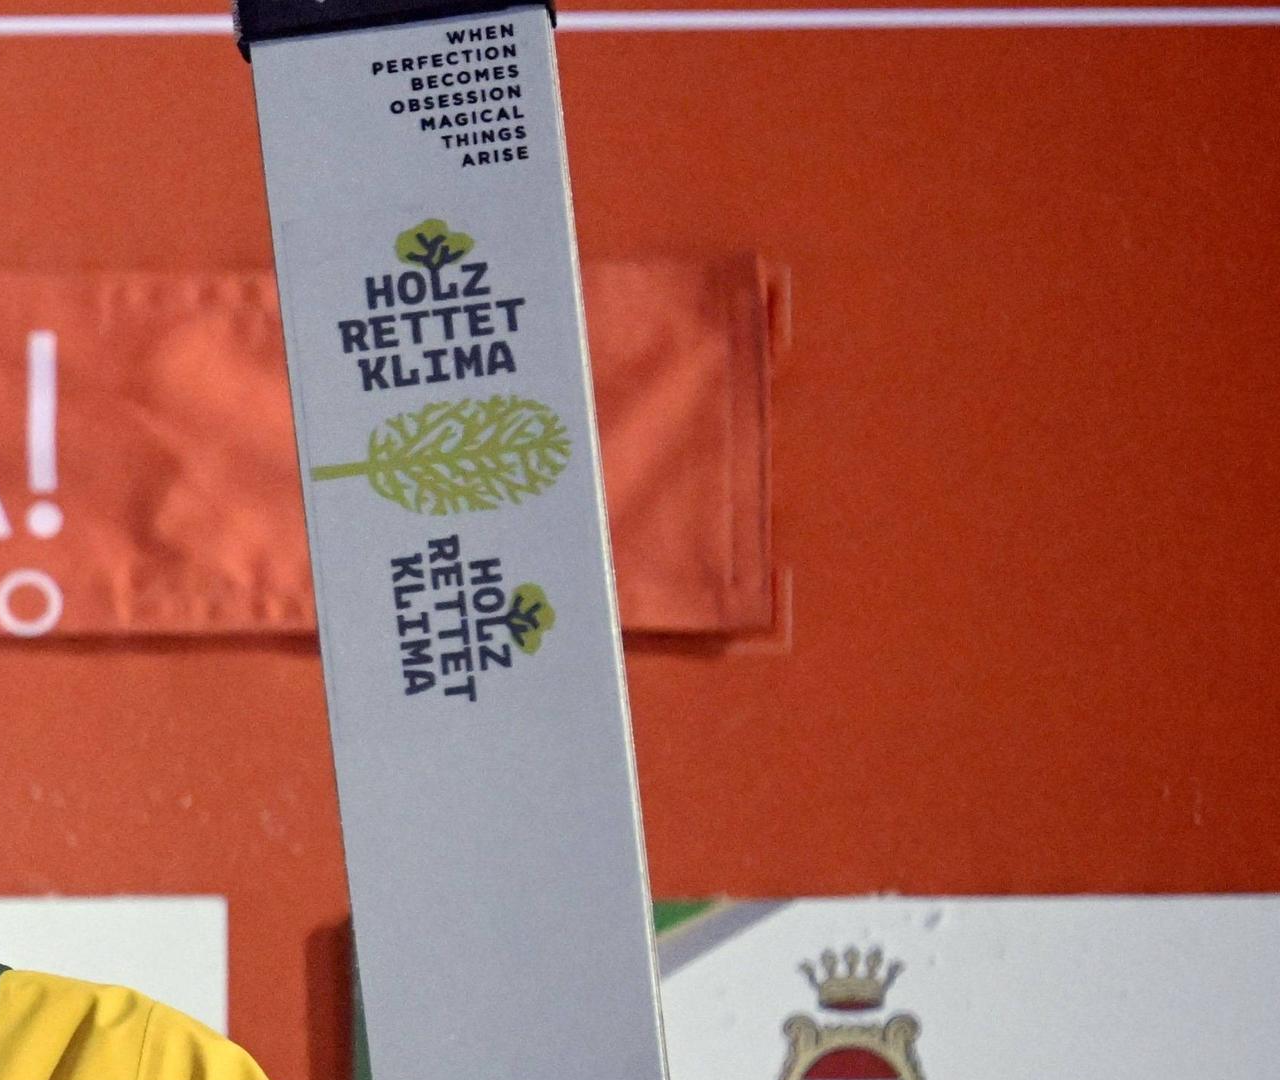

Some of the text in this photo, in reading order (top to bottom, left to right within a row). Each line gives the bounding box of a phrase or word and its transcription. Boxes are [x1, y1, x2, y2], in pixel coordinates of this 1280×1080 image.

[446, 23, 514, 45] WHEN
[371, 43, 517, 75] PERFECTION
[410, 64, 519, 91] BECOMES
[390, 84, 521, 114] OBSESSION
[420, 105, 524, 131] MAGICAL
[441, 126, 527, 148] THINGS
[462, 146, 529, 167] ARISE
[365, 262, 491, 309] HOLZ
[339, 298, 525, 353] RETTET
[360, 341, 517, 391] KLIMA
[390, 553, 436, 696] KLIMA
[428, 535, 477, 702] RETTET
[469, 558, 513, 671] HOLZ
